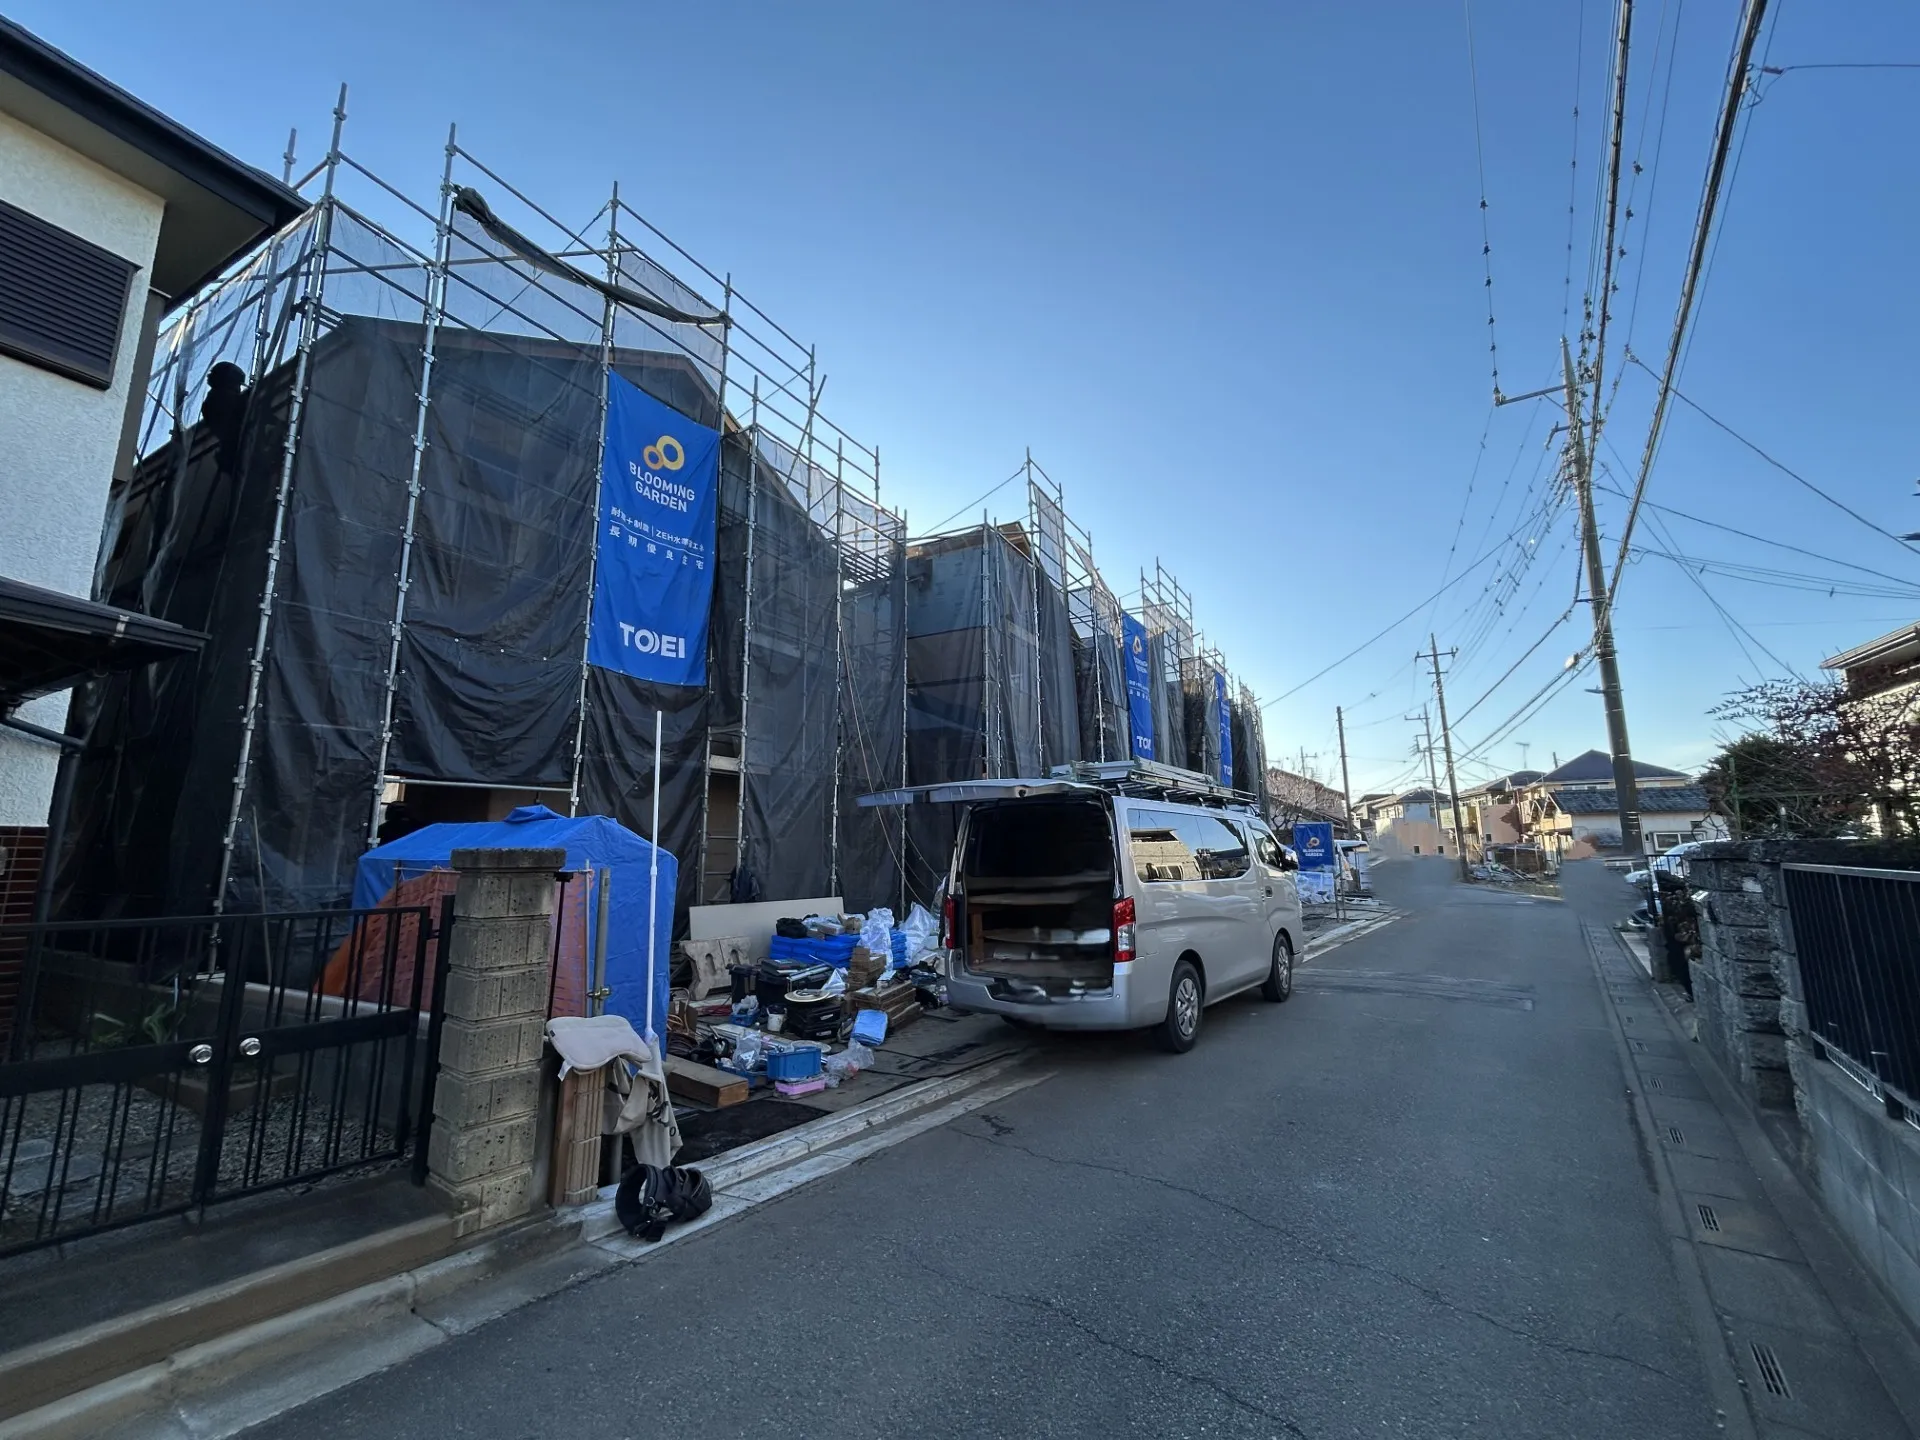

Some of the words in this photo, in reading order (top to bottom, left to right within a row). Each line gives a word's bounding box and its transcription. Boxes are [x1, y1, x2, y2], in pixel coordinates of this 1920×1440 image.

[629, 461, 695, 501] BLOOMING
[635, 480, 688, 513] GARDEN
[619, 621, 686, 659] TOEI
